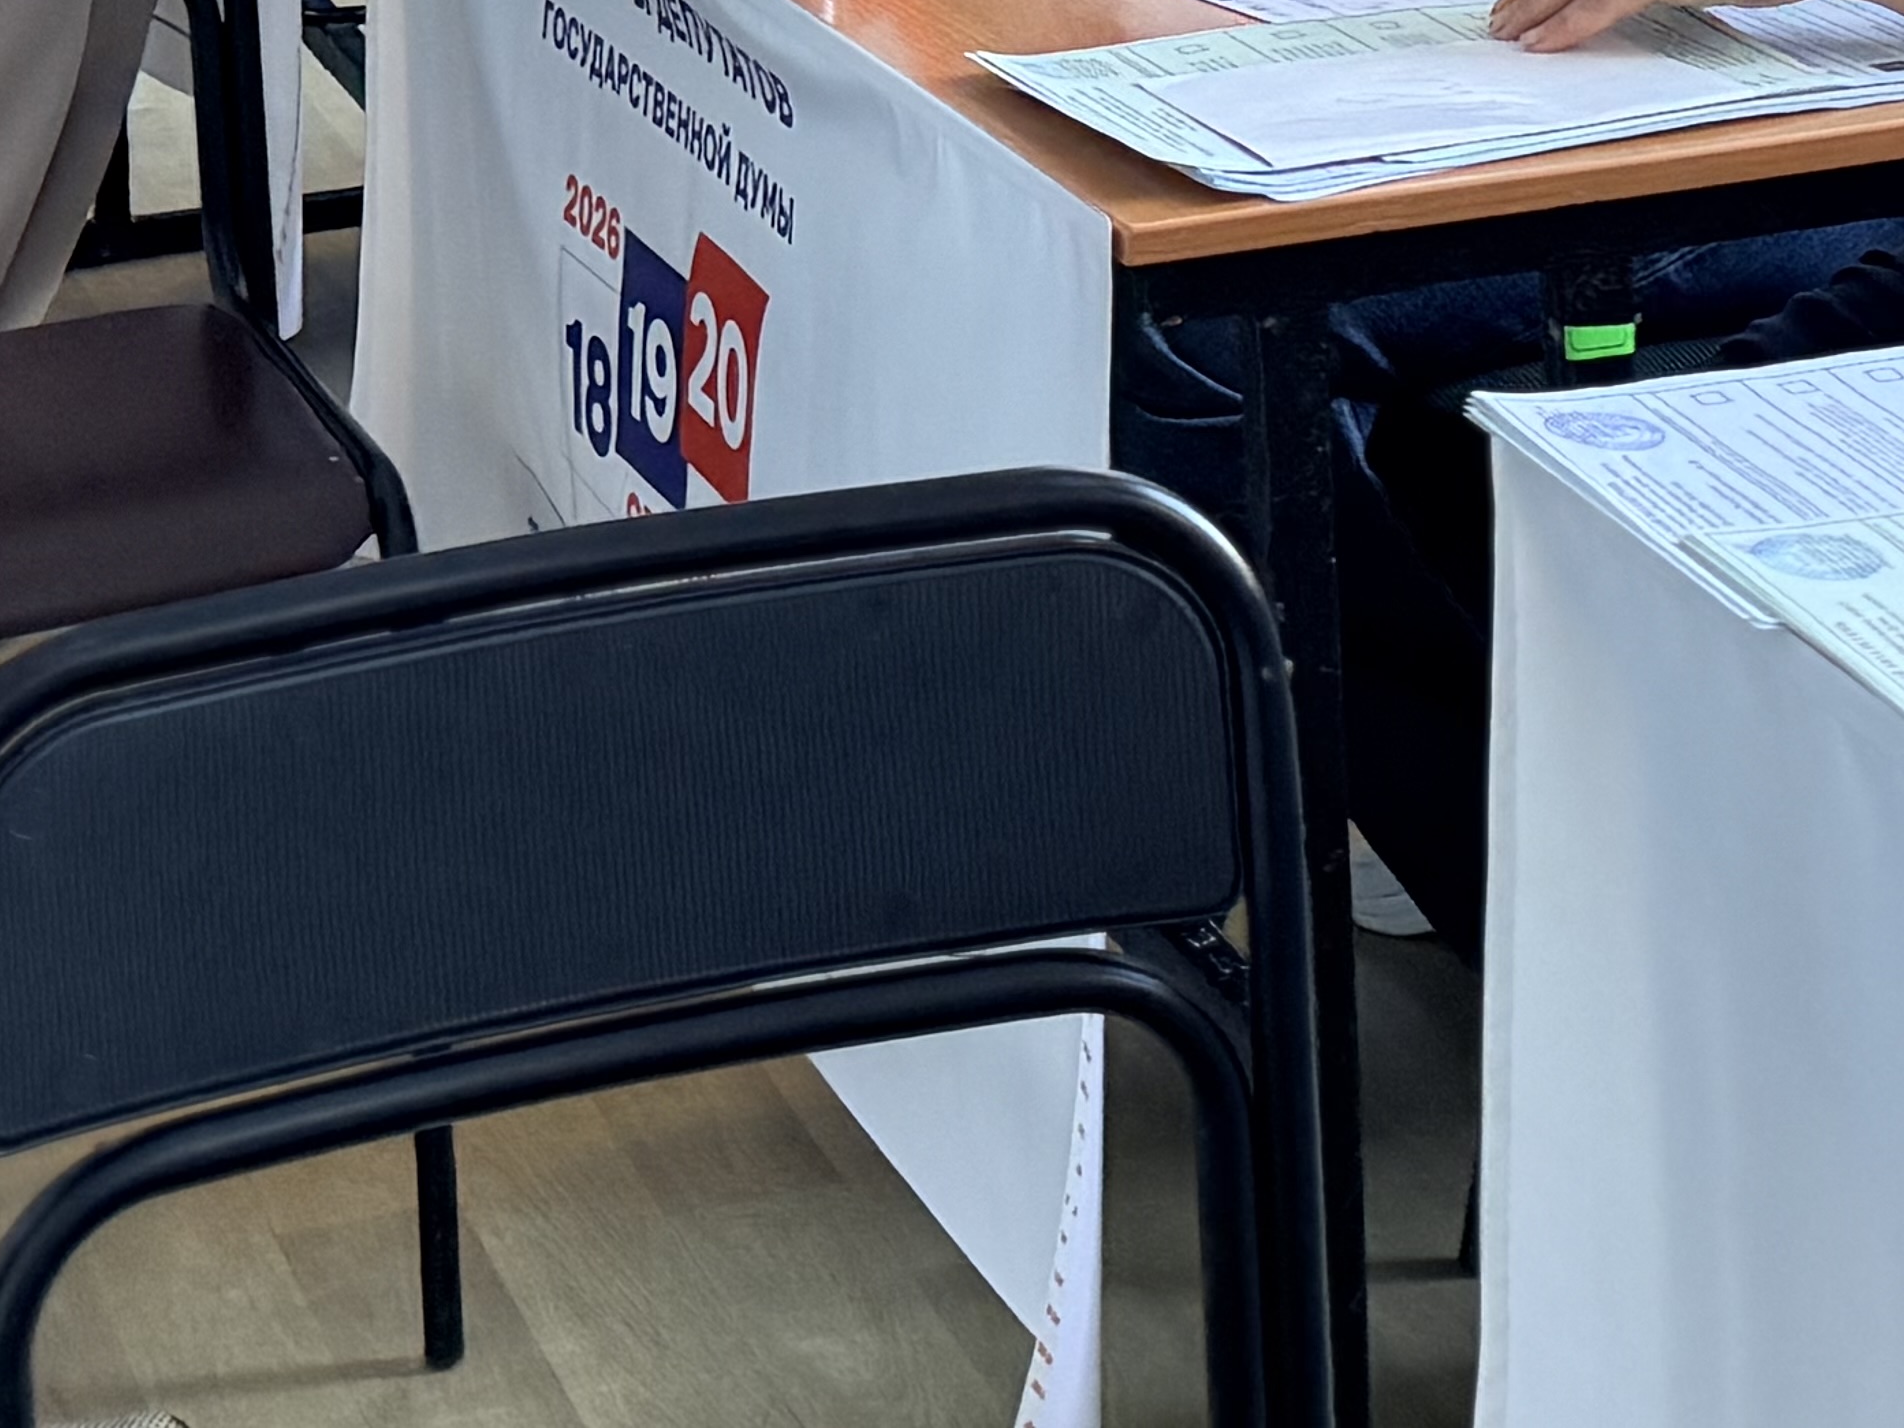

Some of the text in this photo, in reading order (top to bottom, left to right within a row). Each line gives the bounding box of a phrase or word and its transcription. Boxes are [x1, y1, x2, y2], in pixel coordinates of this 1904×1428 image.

[563, 172, 622, 261] 2026
[733, 155, 797, 246] ДУМЫ
[565, 289, 748, 459] 18 19 20
